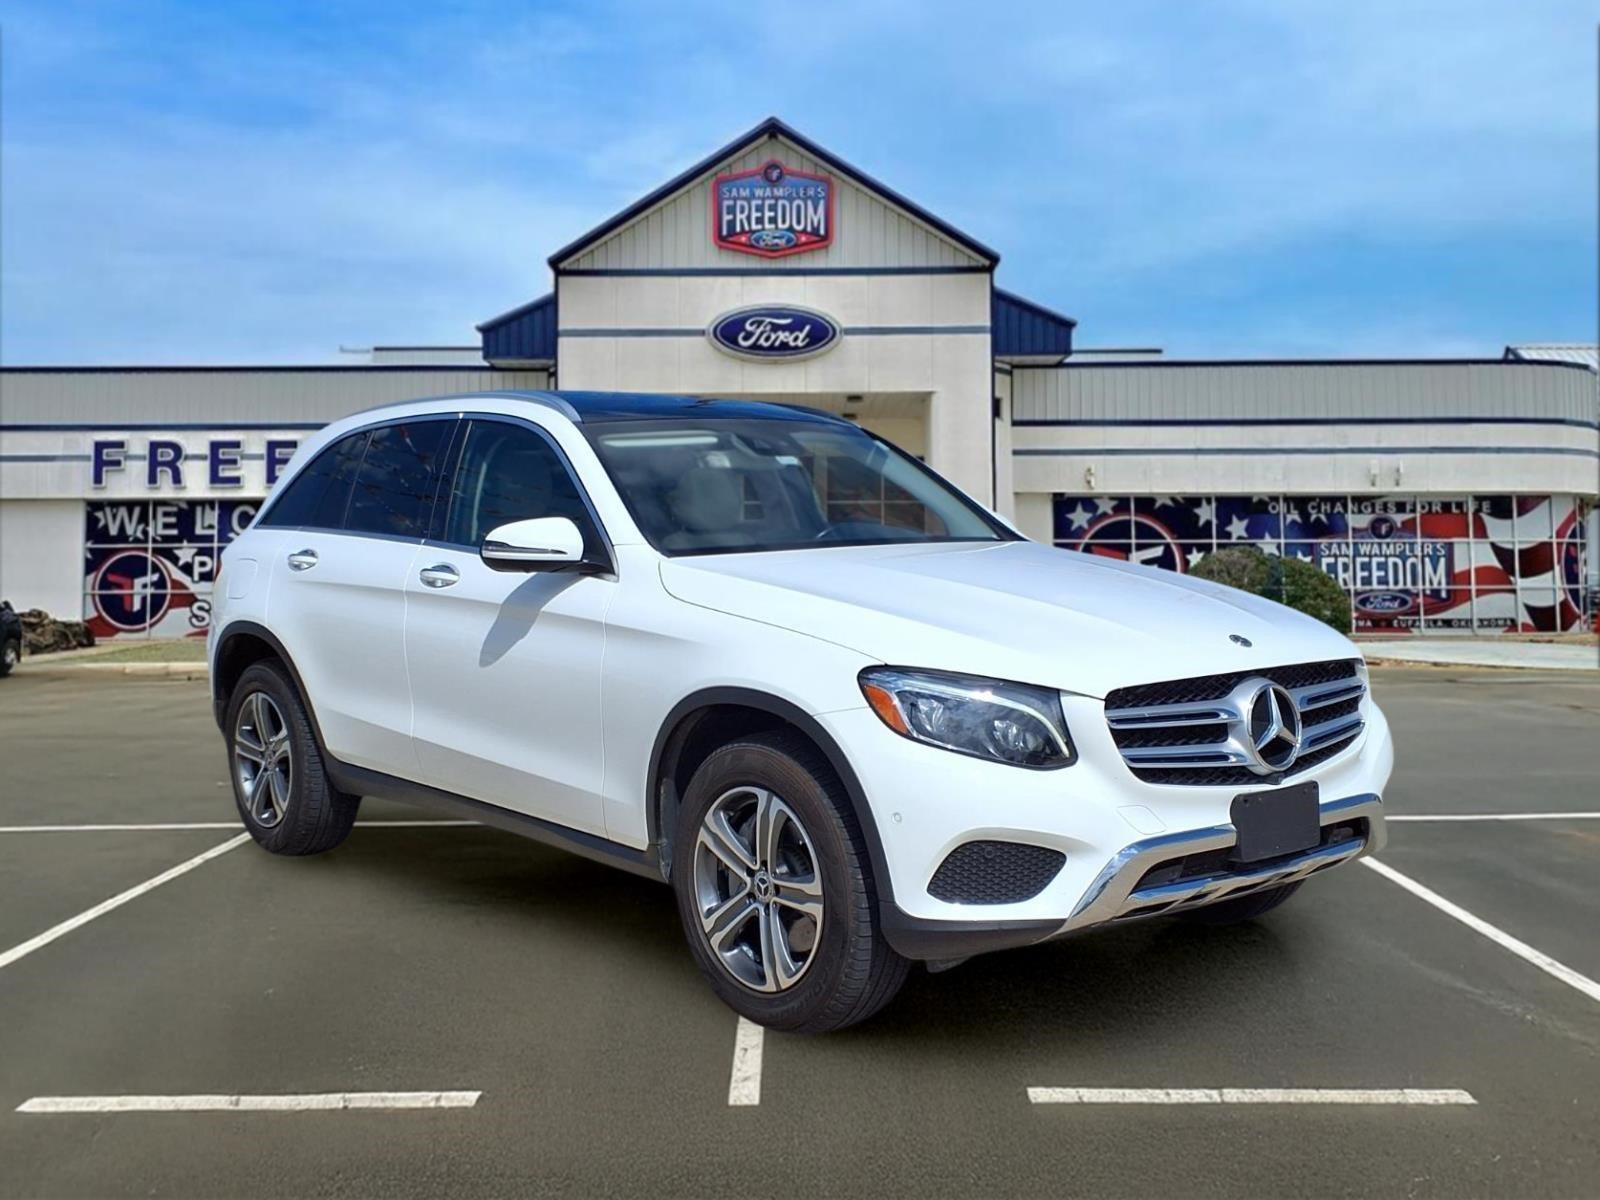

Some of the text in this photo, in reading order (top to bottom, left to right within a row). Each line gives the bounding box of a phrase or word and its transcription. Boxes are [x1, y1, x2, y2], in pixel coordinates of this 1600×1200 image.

[722, 187, 749, 198] SAM
[722, 199, 825, 236] FREEDOM
[759, 232, 787, 247] Ford
[738, 316, 811, 348] Ford
[1268, 502, 1491, 514] OIL CHANGES FOR LIFE
[1320, 543, 1353, 556] SAM
[1321, 557, 1447, 598] FREEDOM
[1366, 595, 1400, 609] Ford
